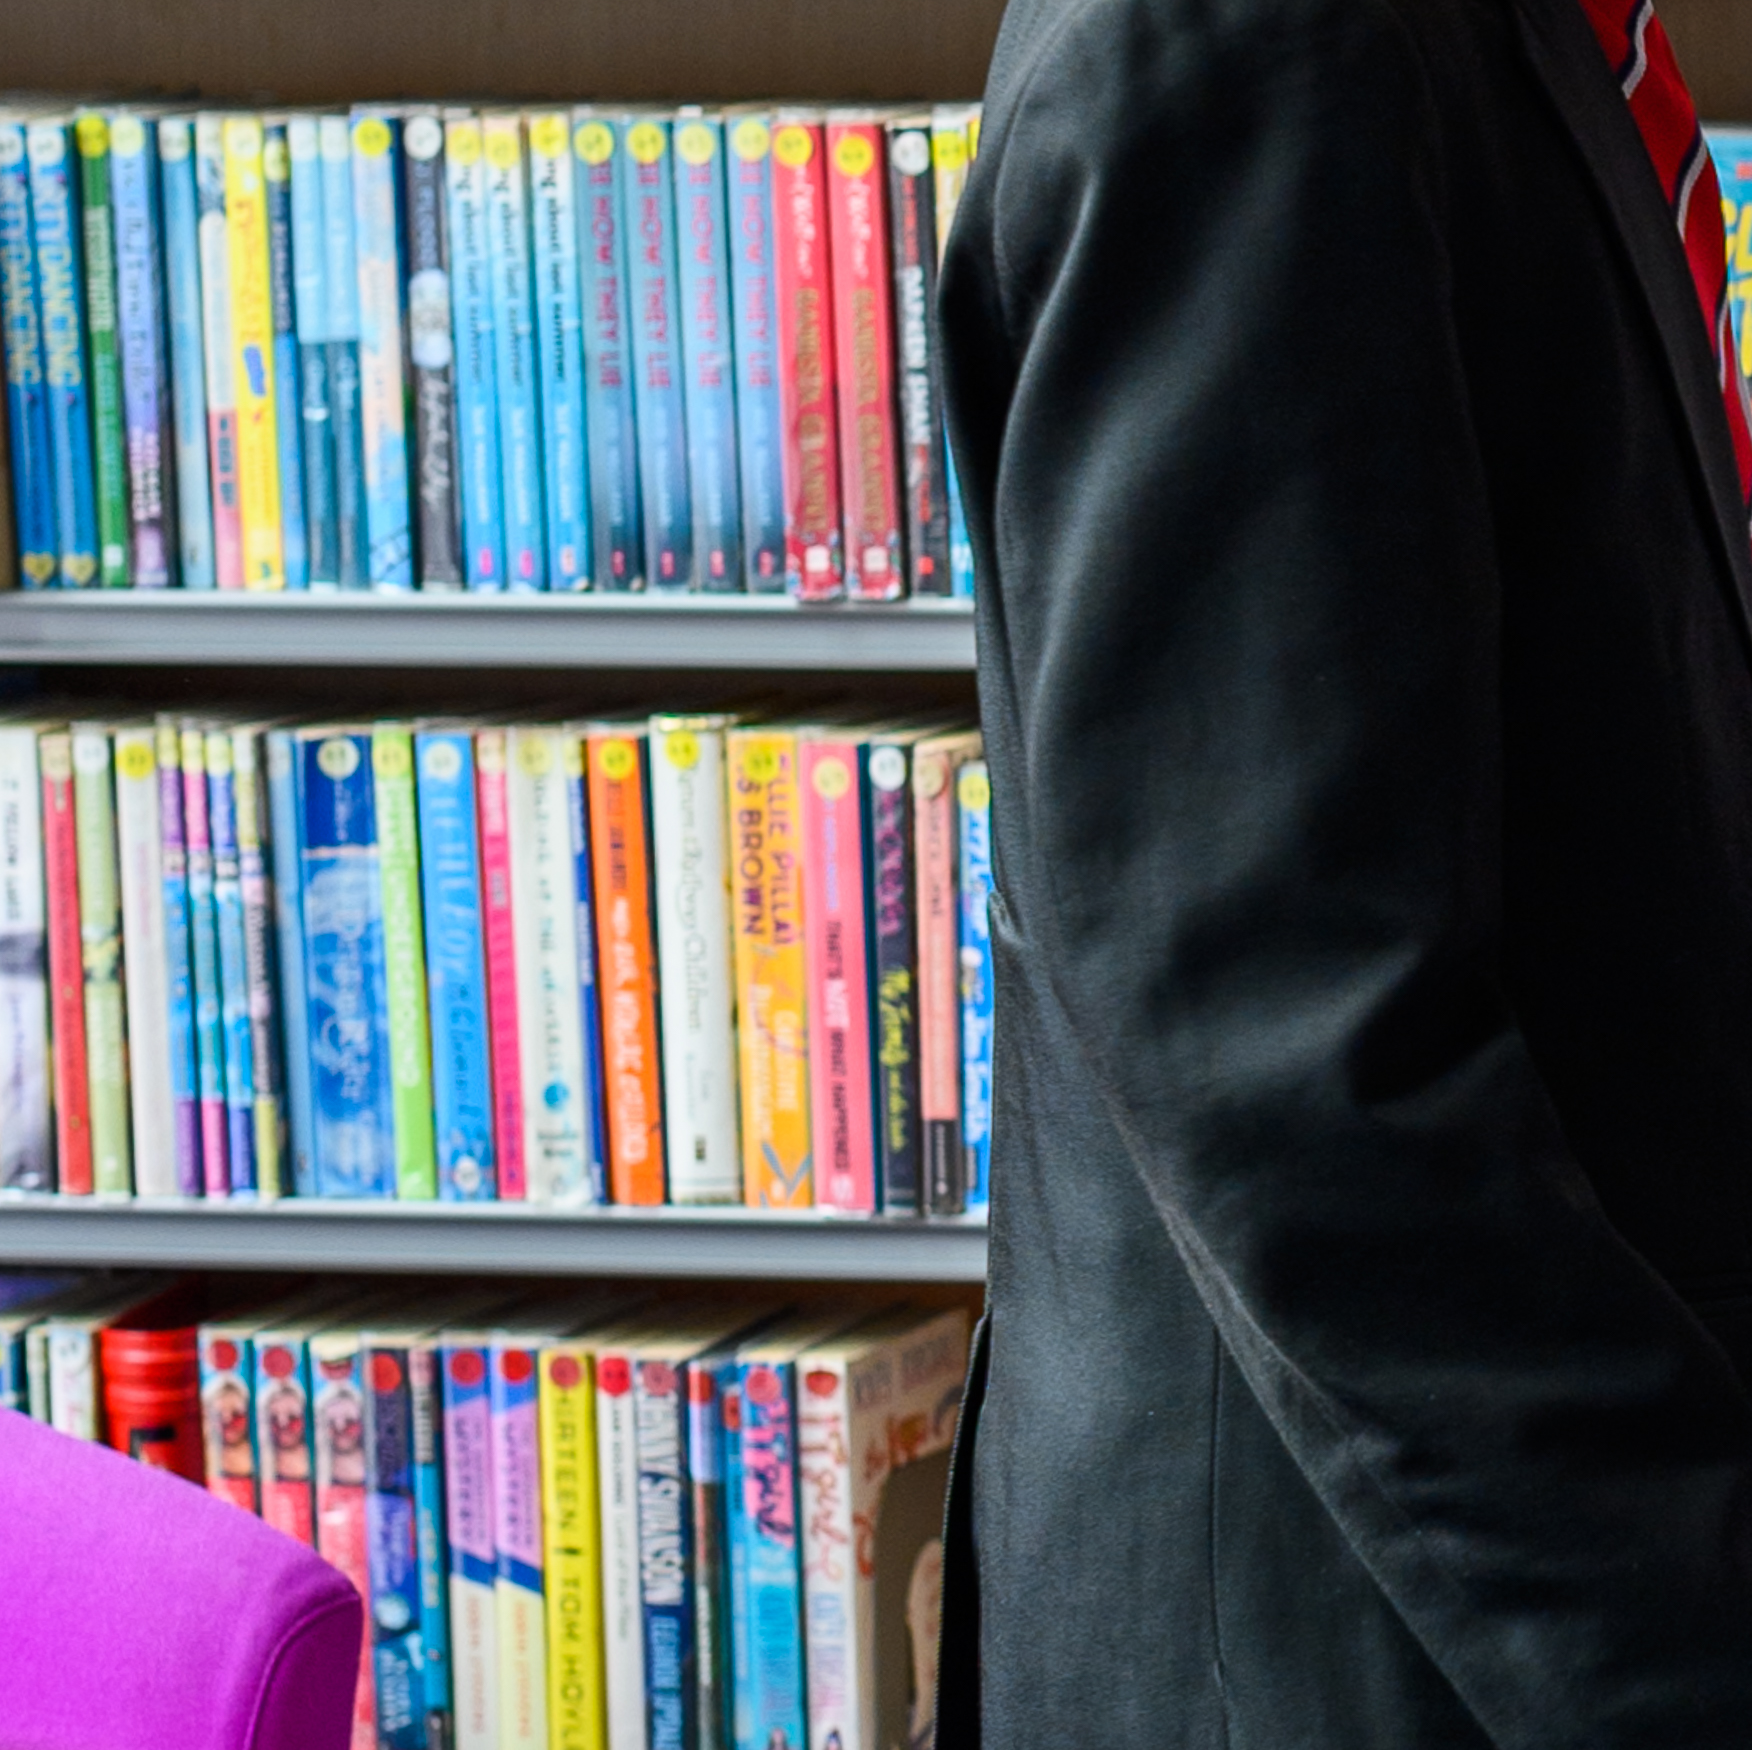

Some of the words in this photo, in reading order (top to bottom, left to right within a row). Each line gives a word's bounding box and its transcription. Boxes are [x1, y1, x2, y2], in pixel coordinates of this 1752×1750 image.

[737, 808, 766, 937] BROWN
[553, 1391, 581, 1534] HIRTEEN
[561, 1576, 584, 1643] TOM
